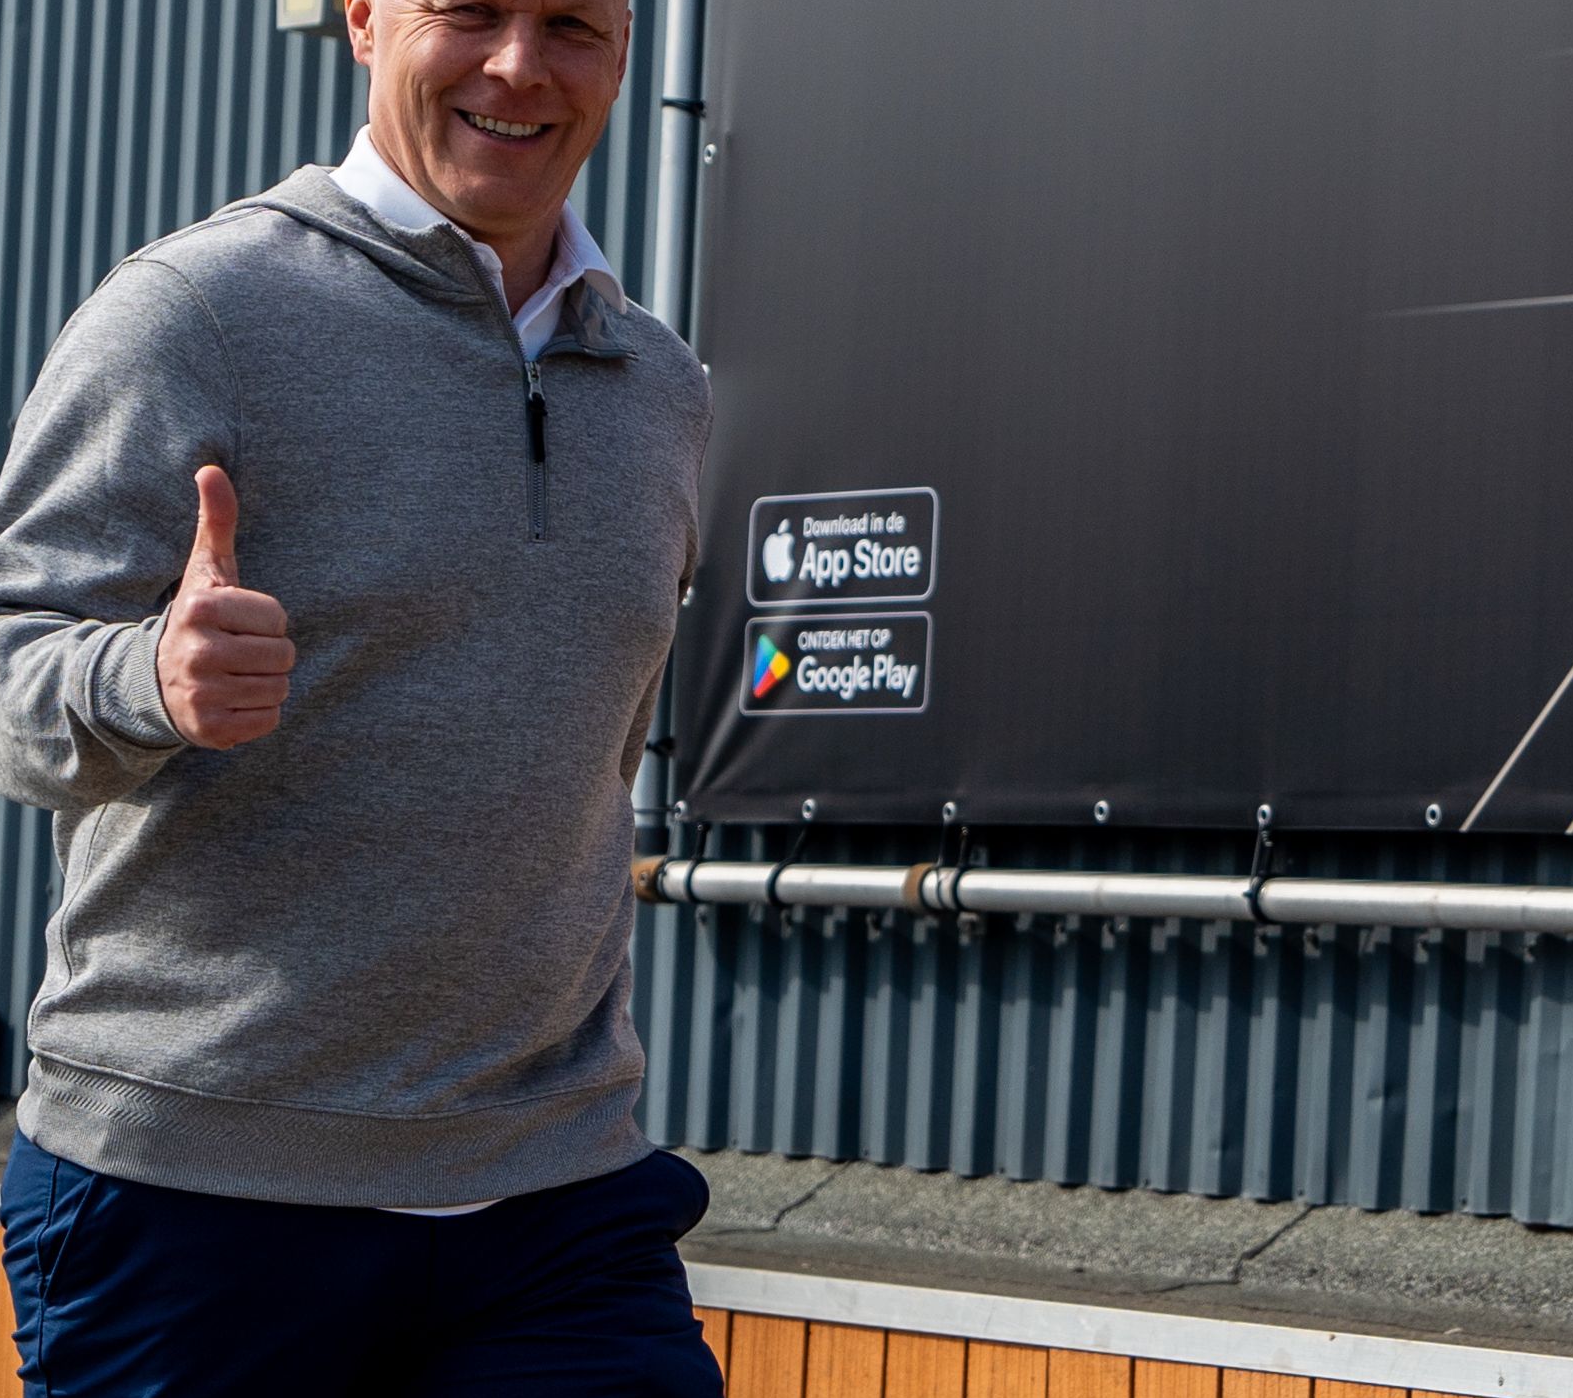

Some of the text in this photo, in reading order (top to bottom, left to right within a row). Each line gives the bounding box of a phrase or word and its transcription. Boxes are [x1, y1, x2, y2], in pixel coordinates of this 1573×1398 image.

[803, 511, 906, 538] Download in de
[798, 538, 922, 588] App Store
[798, 628, 892, 651] ONTDEK HET OP
[797, 653, 919, 700] Google Play
